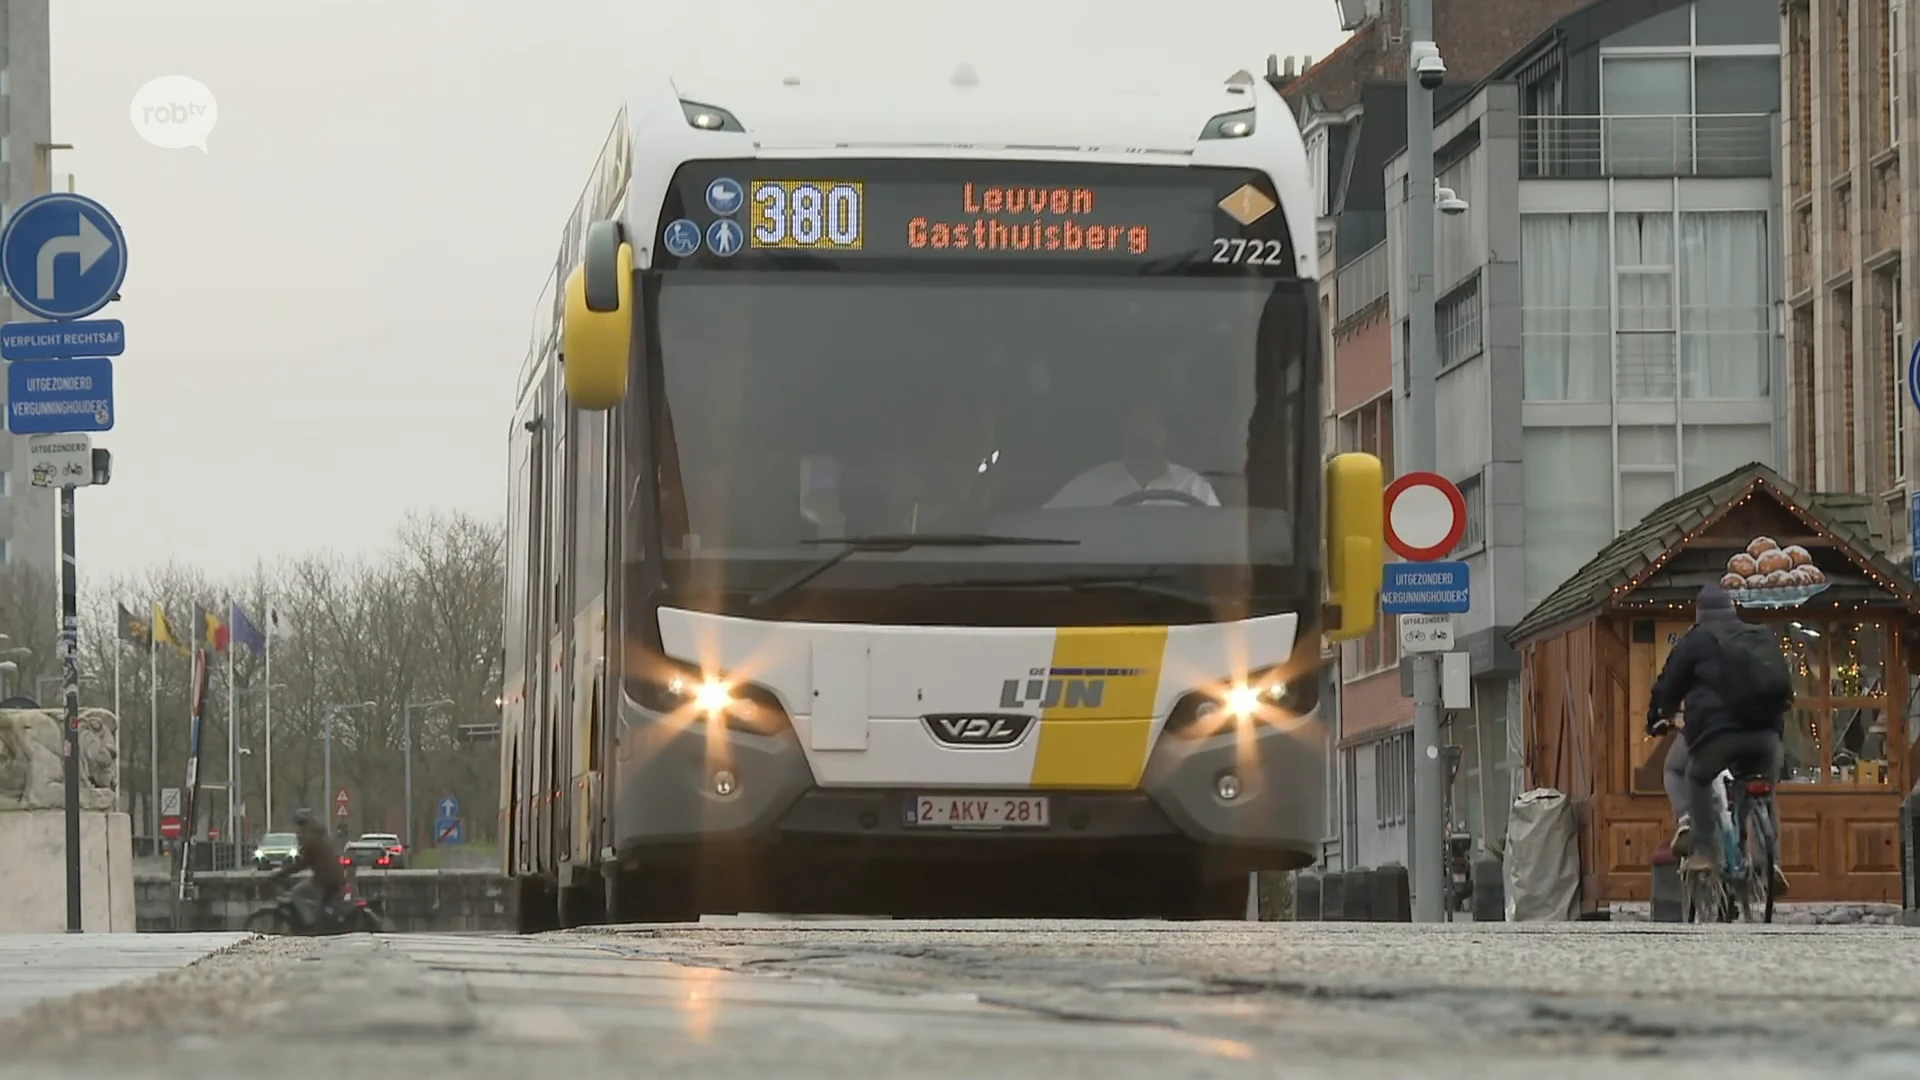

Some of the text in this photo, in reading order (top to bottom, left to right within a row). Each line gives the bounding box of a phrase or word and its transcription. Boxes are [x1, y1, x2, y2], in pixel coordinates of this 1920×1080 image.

[963, 182, 1094, 215] Leuven
[756, 184, 858, 246] 380
[907, 216, 1149, 255] Gasthuisberg
[1212, 238, 1282, 265] 2722
[3, 332, 120, 348] VERPLICHT RECHTSAF
[26, 376, 93, 392] UITGEZONDERD
[12, 400, 108, 416] VERGUNNINGHOUDERS
[1395, 572, 1453, 586] UITGEZONDERD
[999, 679, 1105, 709] LIJN
[939, 719, 1014, 738] VDL
